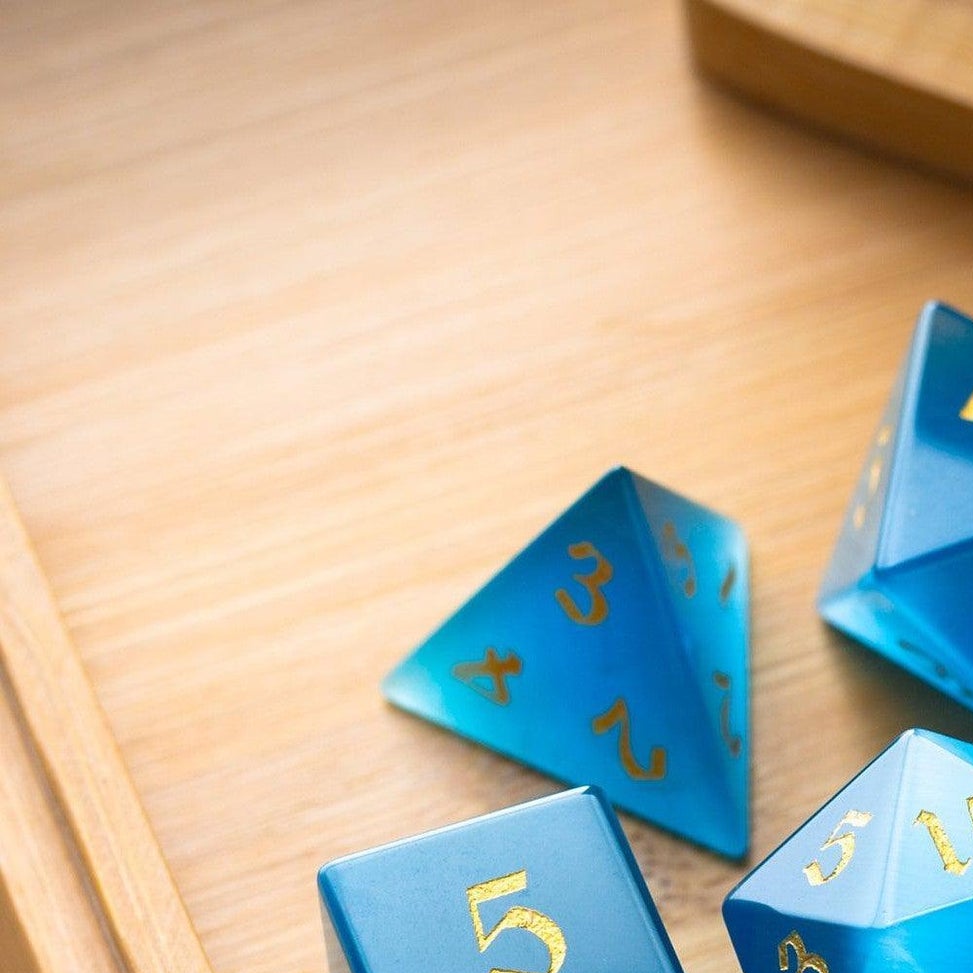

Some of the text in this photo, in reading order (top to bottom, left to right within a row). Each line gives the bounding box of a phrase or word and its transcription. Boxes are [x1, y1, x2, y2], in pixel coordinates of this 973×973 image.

[555, 541, 613, 626] 3
[452, 647, 523, 705] 4
[591, 698, 667, 781] 2
[802, 809, 873, 887] 5
